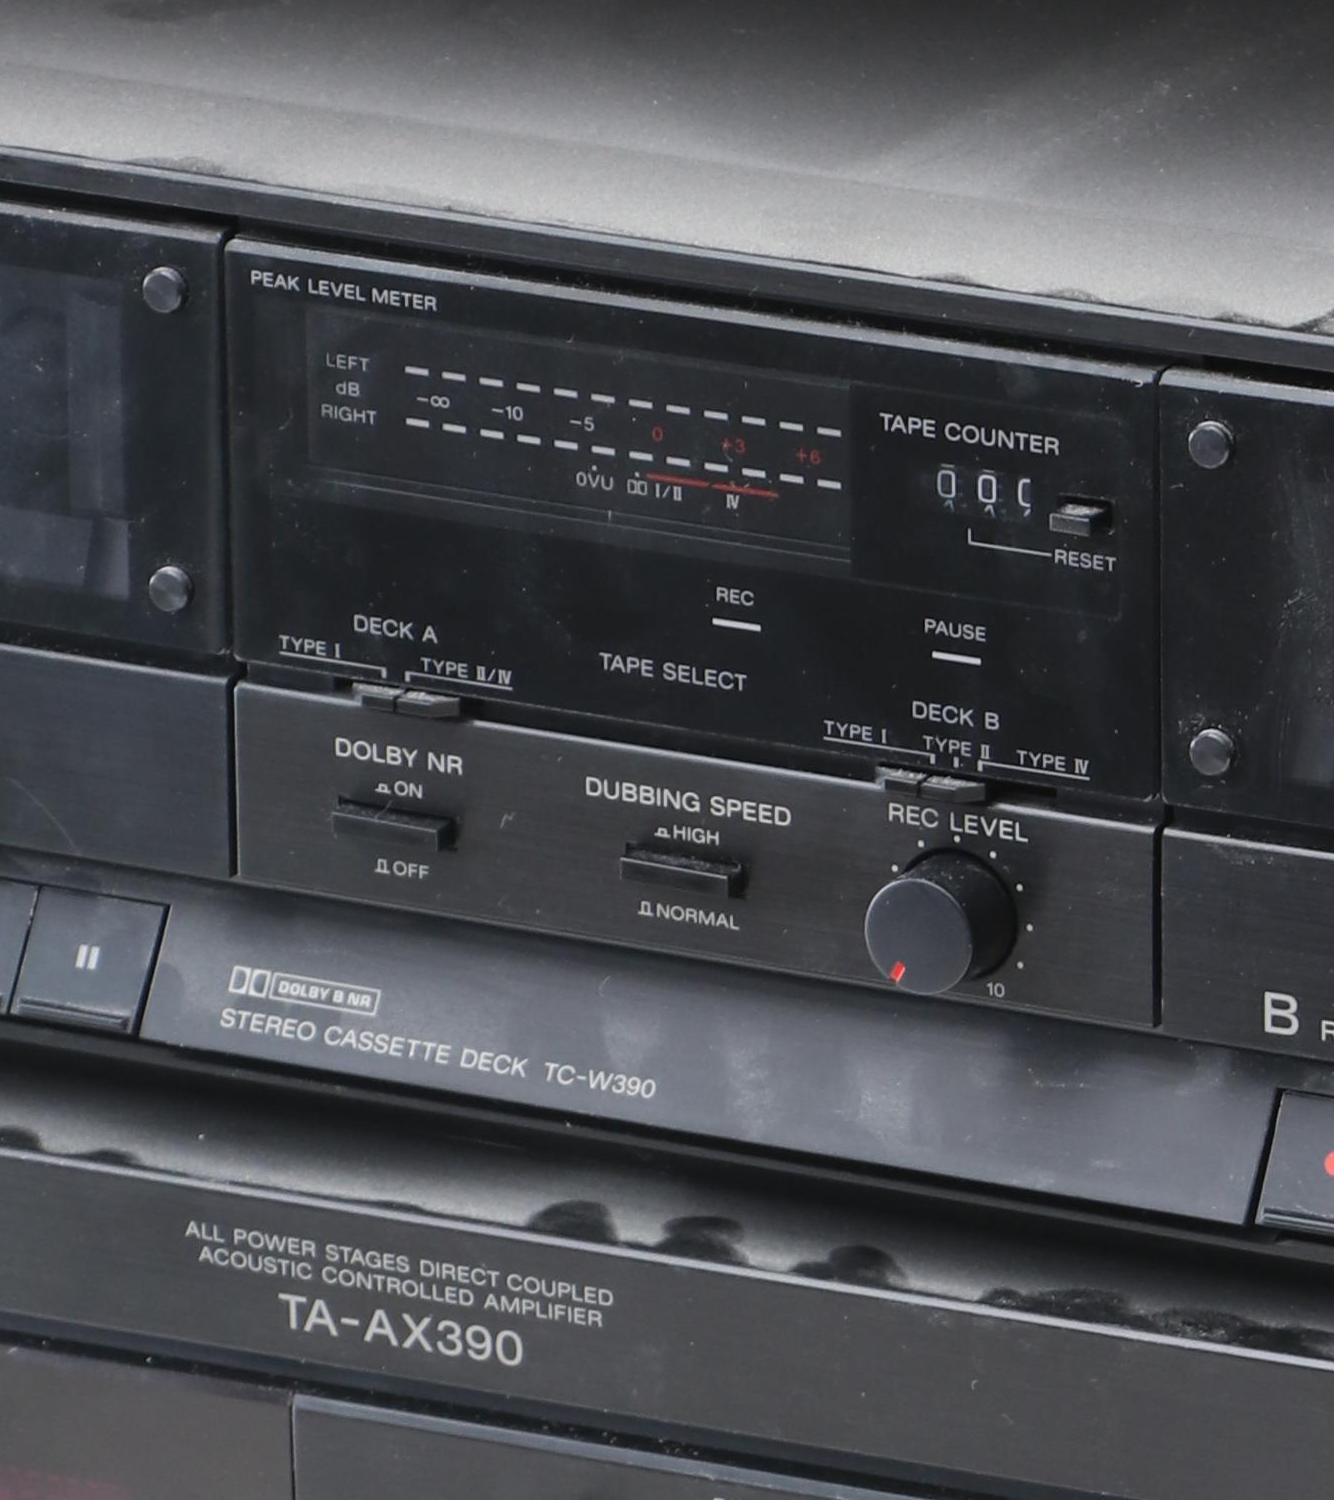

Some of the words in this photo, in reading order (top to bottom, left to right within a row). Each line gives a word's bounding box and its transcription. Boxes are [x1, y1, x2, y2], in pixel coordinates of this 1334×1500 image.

[250, 270, 300, 291] PEAK
[308, 278, 366, 302] LEVEL
[372, 289, 437, 312] METER
[326, 353, 369, 372] LEFT
[321, 404, 377, 425] RIGHT
[880, 412, 935, 438] TAPE
[944, 422, 1060, 456] COUNTER
[1054, 550, 1116, 572] RESET
[716, 587, 754, 606] REC
[354, 614, 413, 641] DECK
[422, 625, 438, 644] A
[924, 619, 986, 642] PAUSE
[279, 635, 327, 656] TYPE
[421, 657, 468, 678] TYPE
[599, 652, 653, 677] TAPE
[662, 663, 747, 692] SELECT
[824, 720, 872, 740] TYPE
[912, 701, 974, 727] DECK
[985, 713, 999, 731] B
[334, 736, 419, 771] DOLBY
[427, 751, 464, 777] NR
[923, 736, 971, 757] TYPE
[1016, 749, 1066, 771] TYPE
[394, 781, 423, 800] ON
[584, 777, 700, 814] DUBBING
[708, 796, 792, 828] SPEED
[672, 825, 720, 847] HIGH
[888, 804, 940, 831] REC
[949, 811, 1029, 844] LEVEL
[393, 861, 429, 880] OFF
[656, 902, 740, 931] NORMAL
[278, 980, 329, 1001] DOLBY
[332, 988, 344, 1002] B
[348, 991, 372, 1009] NR
[987, 982, 1005, 998] 10
[1262, 992, 1300, 1036] B
[220, 1008, 316, 1043] STEREO
[324, 1025, 450, 1065] CASSETTE
[460, 1049, 529, 1078] DECK
[544, 1062, 656, 1099] TC-W390
[184, 1220, 225, 1244] ALL
[234, 1228, 316, 1258] POWER
[326, 1244, 410, 1273] STAGES
[420, 1259, 500, 1287] DIRECT
[506, 1274, 613, 1307] COUPLED
[199, 1245, 313, 1280] ACOUSTIC
[322, 1265, 474, 1307] CONTROLLED
[483, 1293, 603, 1328] AMPLIFIER
[279, 1293, 524, 1367] TA-AX390
